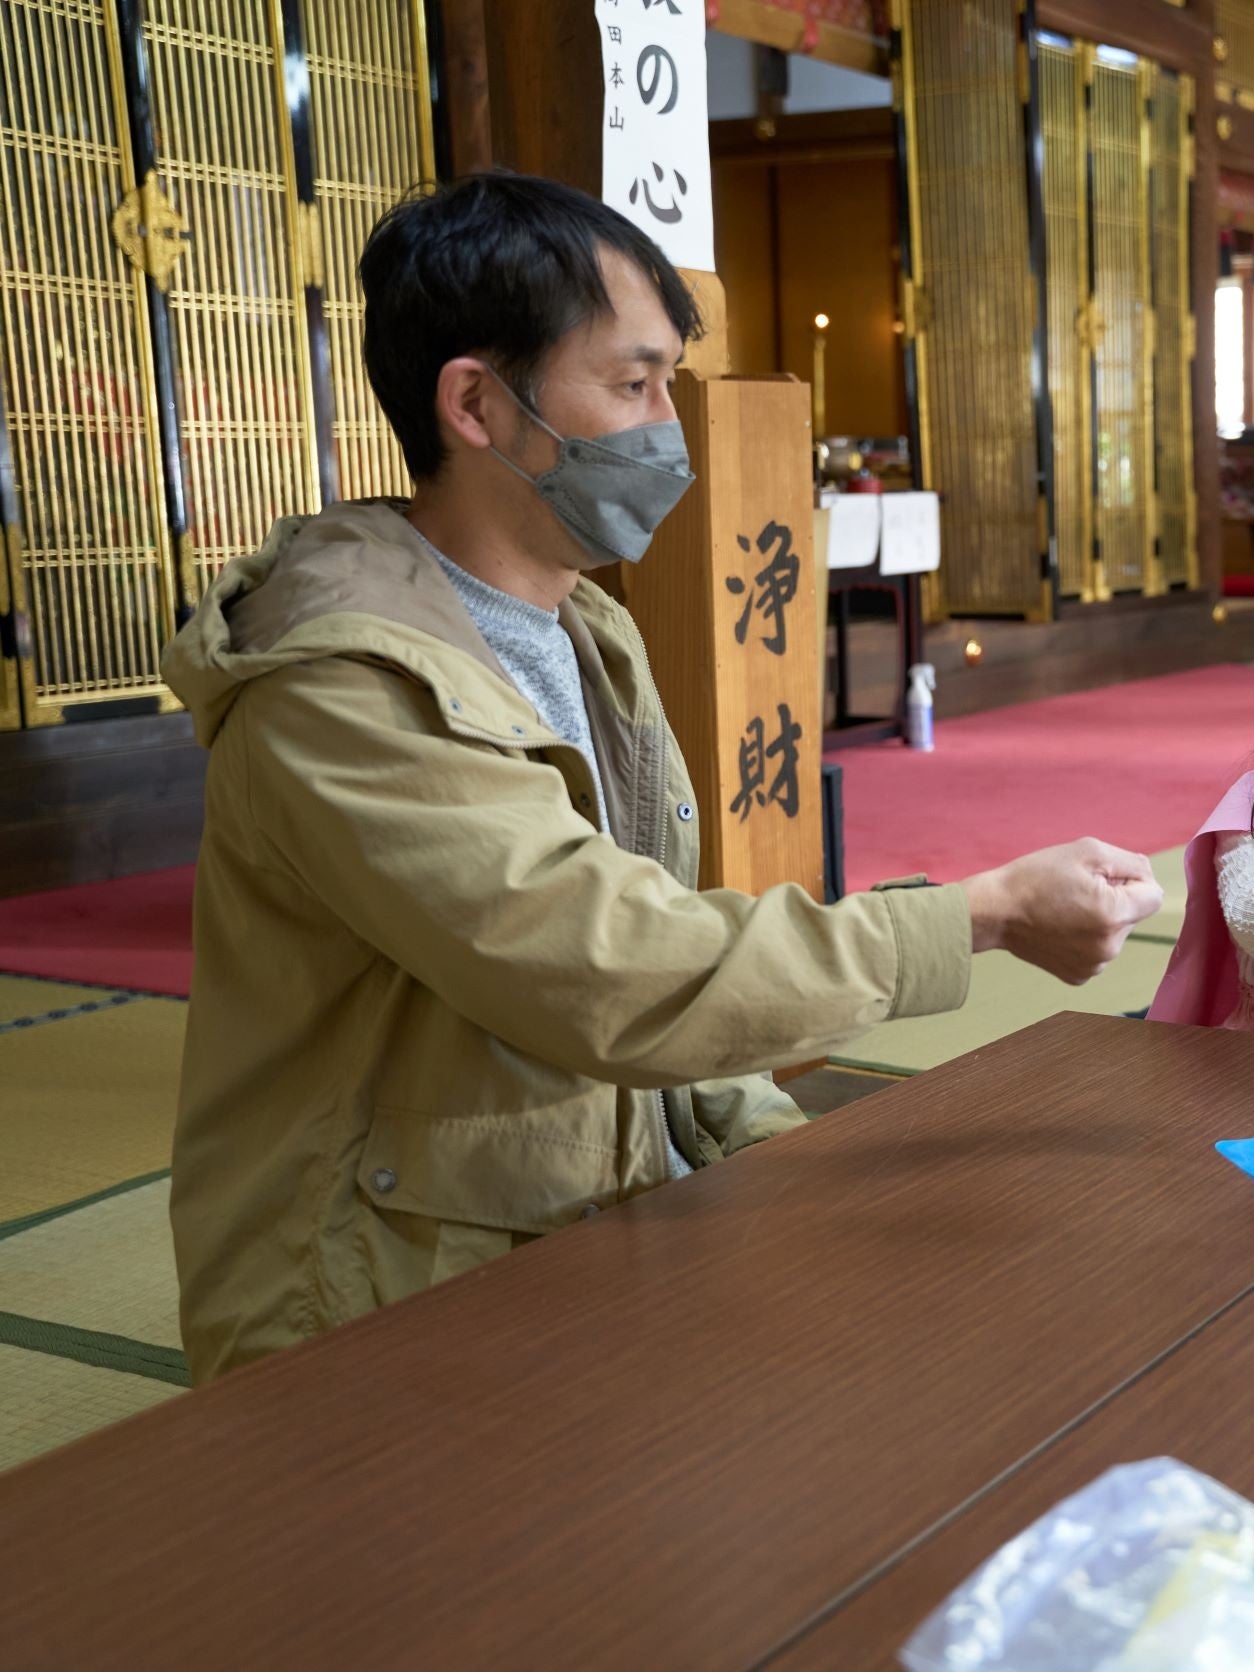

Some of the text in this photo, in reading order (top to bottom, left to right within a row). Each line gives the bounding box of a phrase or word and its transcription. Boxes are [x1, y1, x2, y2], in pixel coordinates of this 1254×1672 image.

[605, 0, 625, 131] 田本山
[725, 520, 802, 824] 浄財
